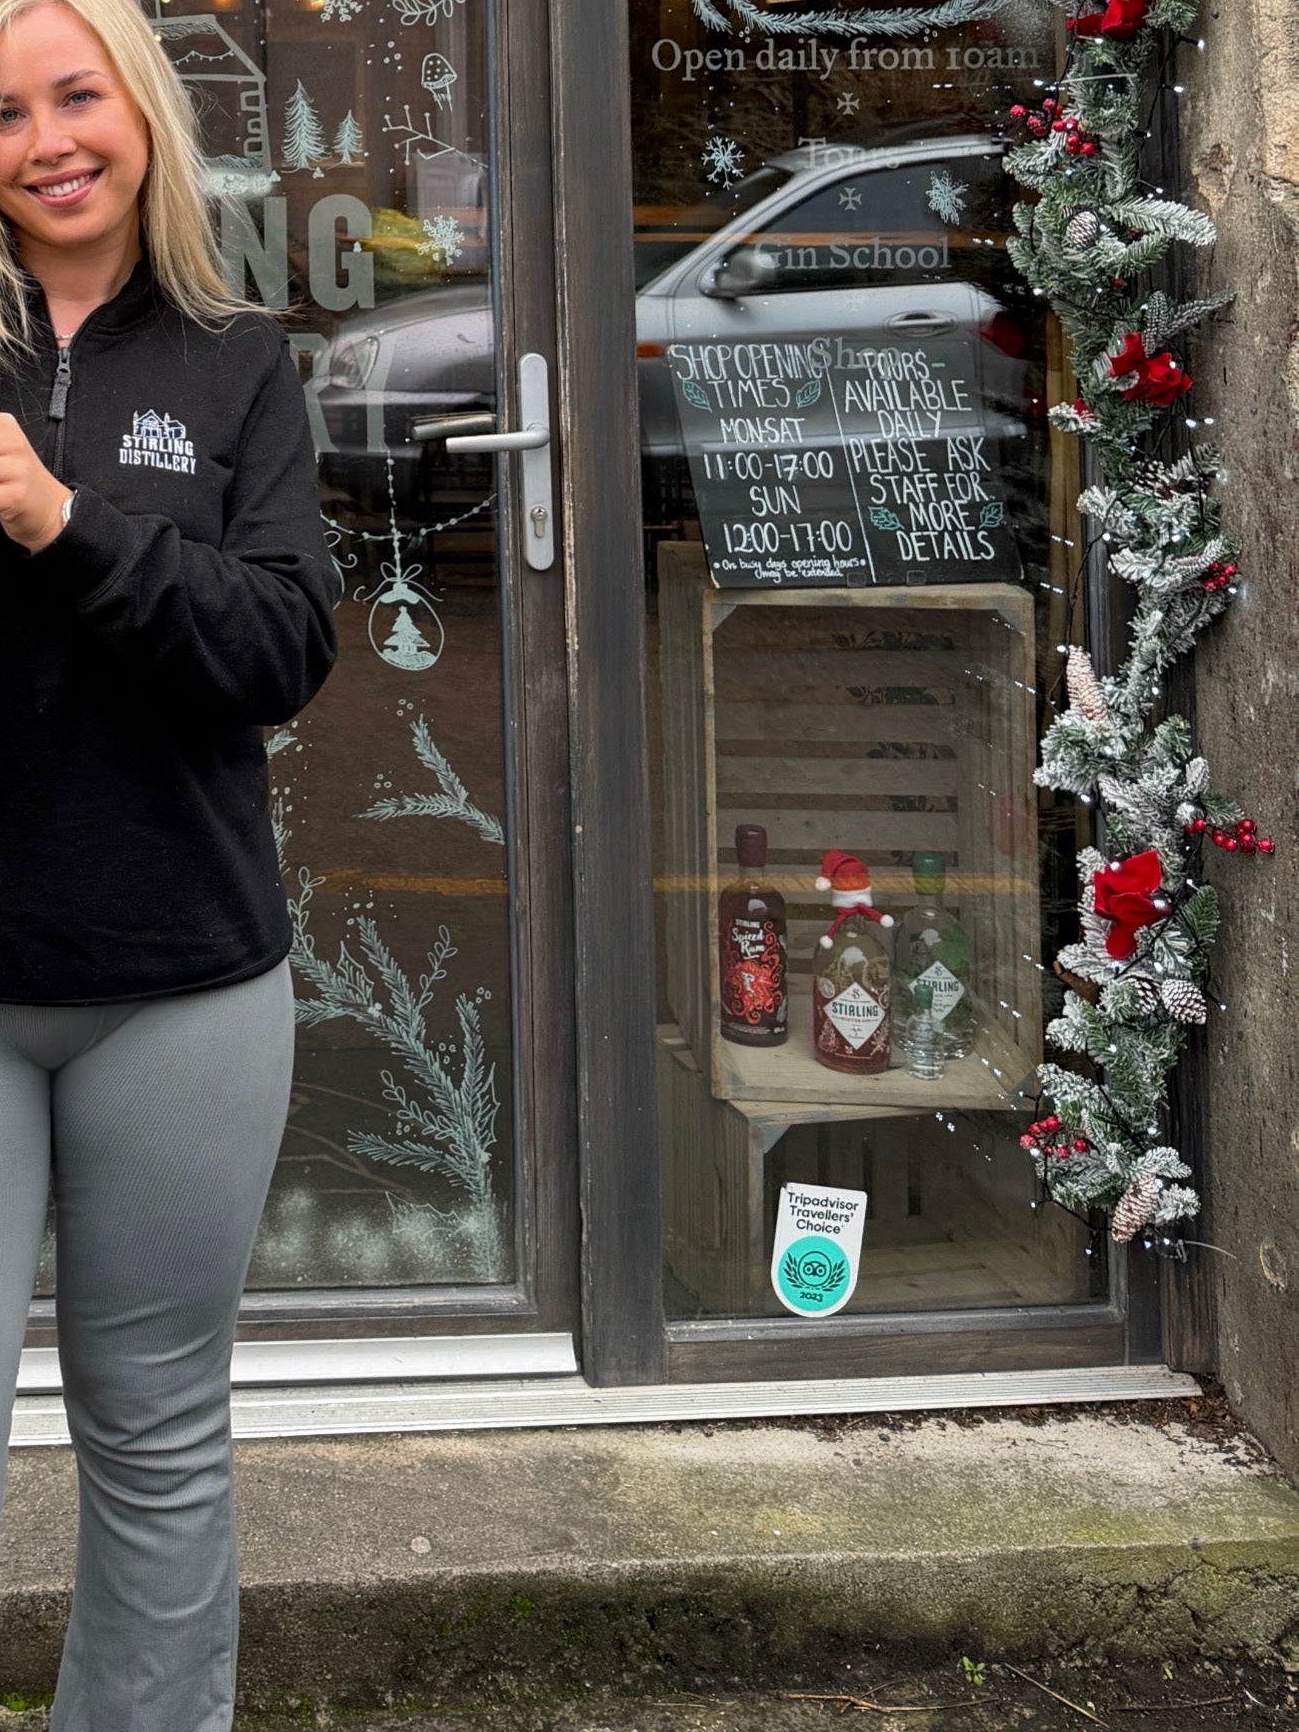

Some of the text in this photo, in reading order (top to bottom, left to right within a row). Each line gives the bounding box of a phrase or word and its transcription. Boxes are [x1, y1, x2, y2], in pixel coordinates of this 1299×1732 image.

[651, 37, 1039, 82] Open daily from 10am
[798, 135, 901, 169] Tours
[754, 235, 952, 269] Gin School
[671, 344, 823, 380] SHOP OPENING
[810, 336, 902, 380] Shop
[861, 349, 930, 381] TOURS
[707, 378, 791, 409] TIMES
[845, 379, 972, 412] AVAILABLE
[720, 417, 805, 445] MON-SAT
[877, 410, 941, 438] DAILY
[122, 434, 195, 457] STIRLING
[850, 435, 991, 473] PLEASE ASK
[119, 448, 197, 475] DISTILLERY
[704, 451, 834, 481] 11:00-17:00
[749, 485, 801, 517] SUN
[869, 472, 989, 504] STAFF FOR
[909, 500, 975, 532] MORE
[723, 520, 852, 554] 12:00-17:00
[896, 530, 995, 561] DETAILS
[722, 554, 859, 574] On busy days opening hours
[784, 569, 799, 577] be
[731, 927, 765, 944] Spiced
[831, 1001, 879, 1018] STIRLING
[787, 1192, 859, 1211] Tripadvisor
[789, 1204, 854, 1223] Travellers'
[796, 1218, 841, 1235] Choice
[799, 1291, 824, 1303] 2023
